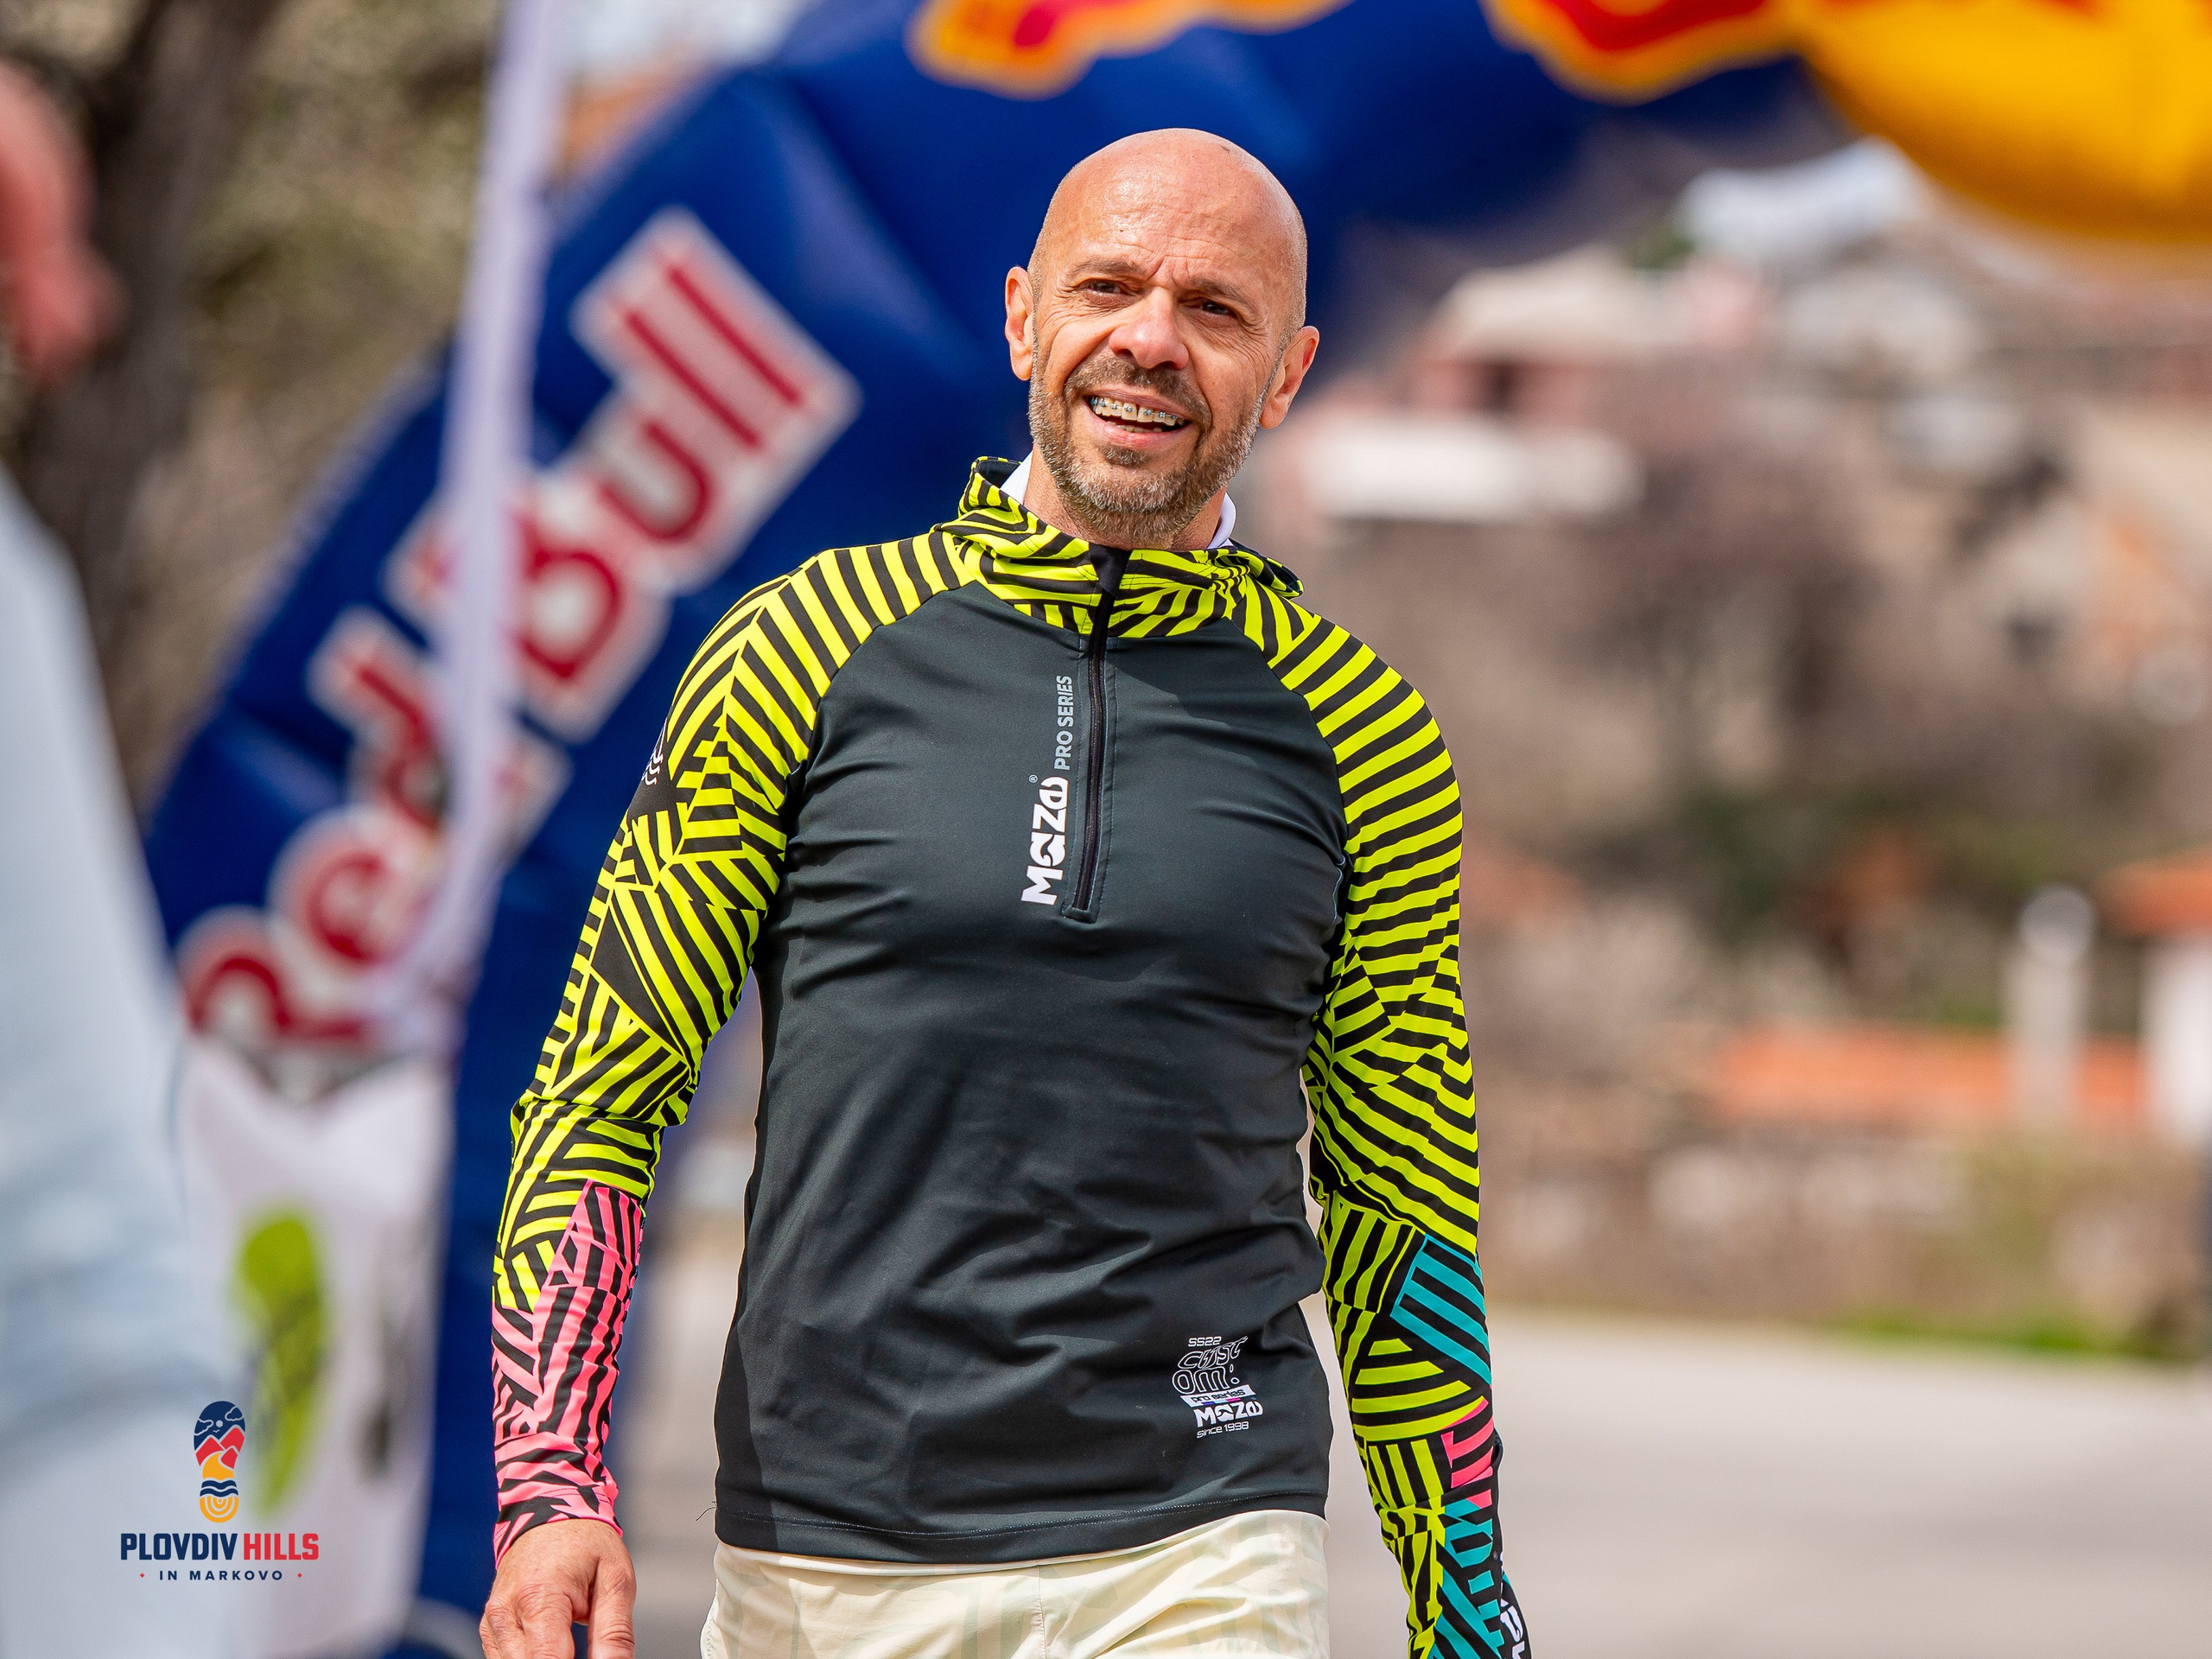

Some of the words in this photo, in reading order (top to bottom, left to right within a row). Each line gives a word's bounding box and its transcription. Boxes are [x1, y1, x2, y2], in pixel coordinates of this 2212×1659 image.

[1056, 675, 1074, 728] SERIES
[1053, 730, 1074, 770] PRO
[1197, 1426, 1223, 1439] since
[1224, 1421, 1249, 1432] 1998
